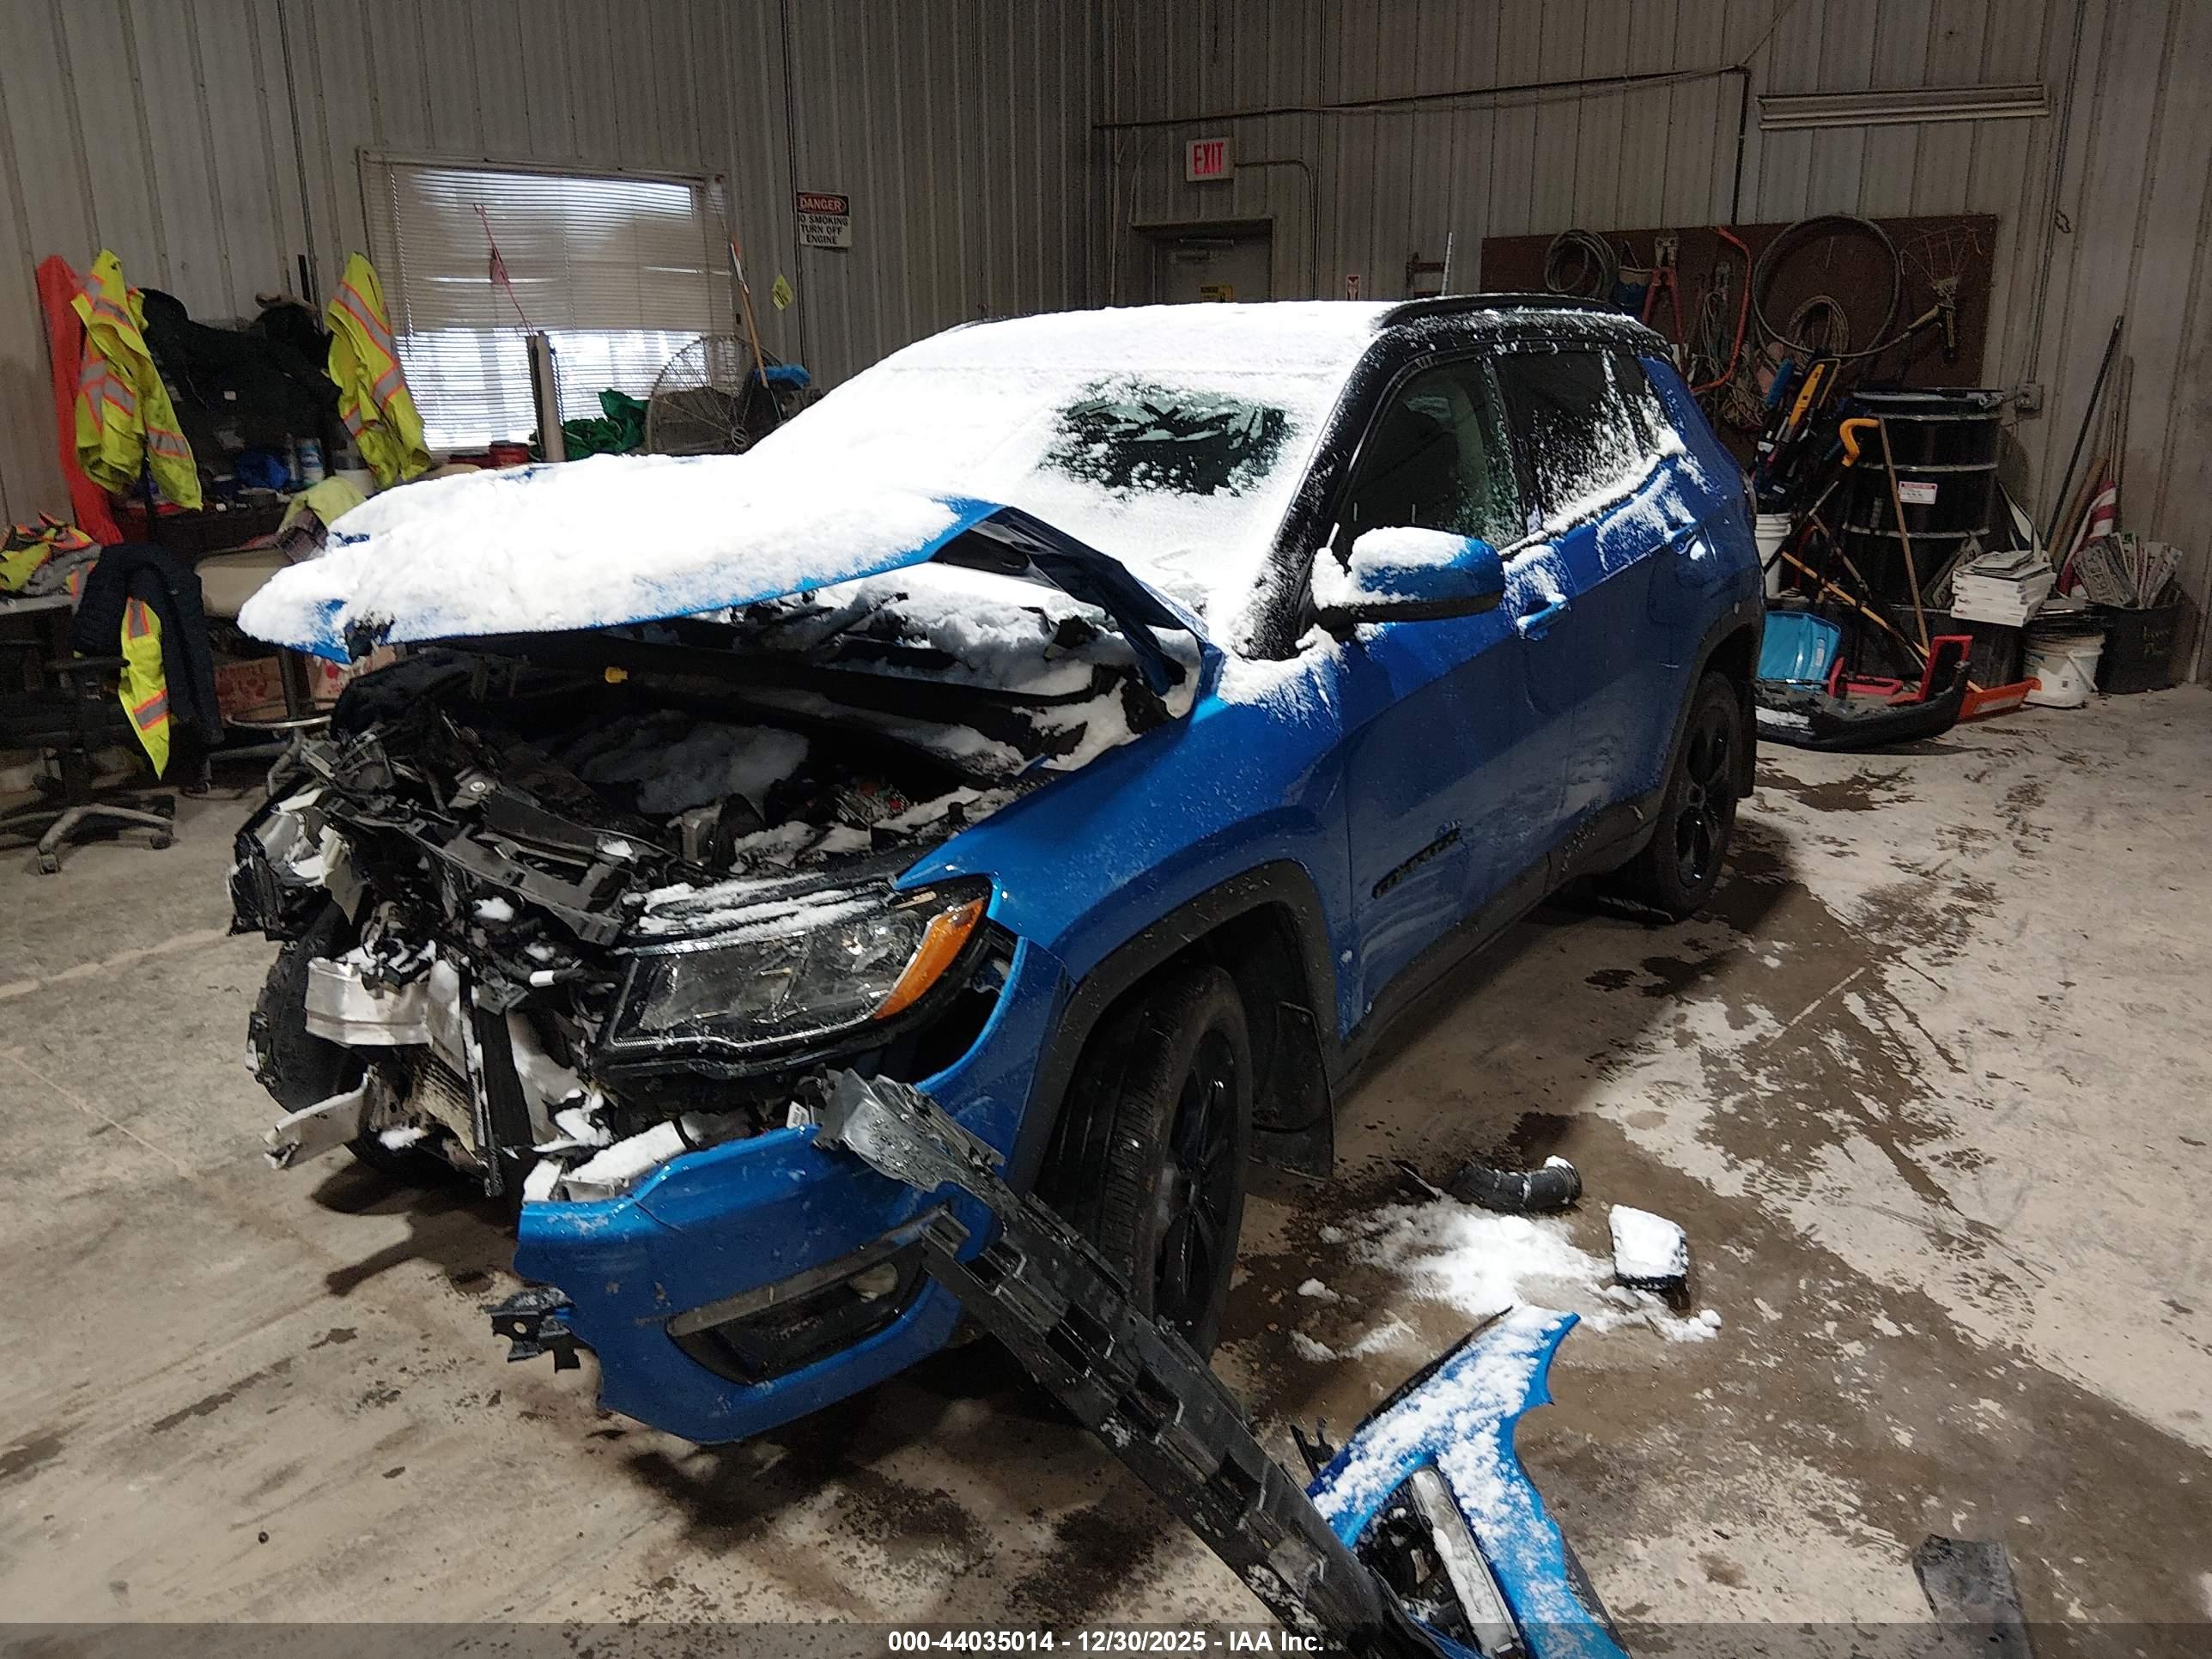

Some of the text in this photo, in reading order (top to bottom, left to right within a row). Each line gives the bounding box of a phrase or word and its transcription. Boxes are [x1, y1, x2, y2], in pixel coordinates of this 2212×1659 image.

[1194, 143, 1224, 174] EXIT
[800, 198, 842, 211] DANGER
[809, 215, 848, 227] SMOKING
[800, 223, 842, 235] TURN OFF
[806, 234, 837, 245] ENGINE
